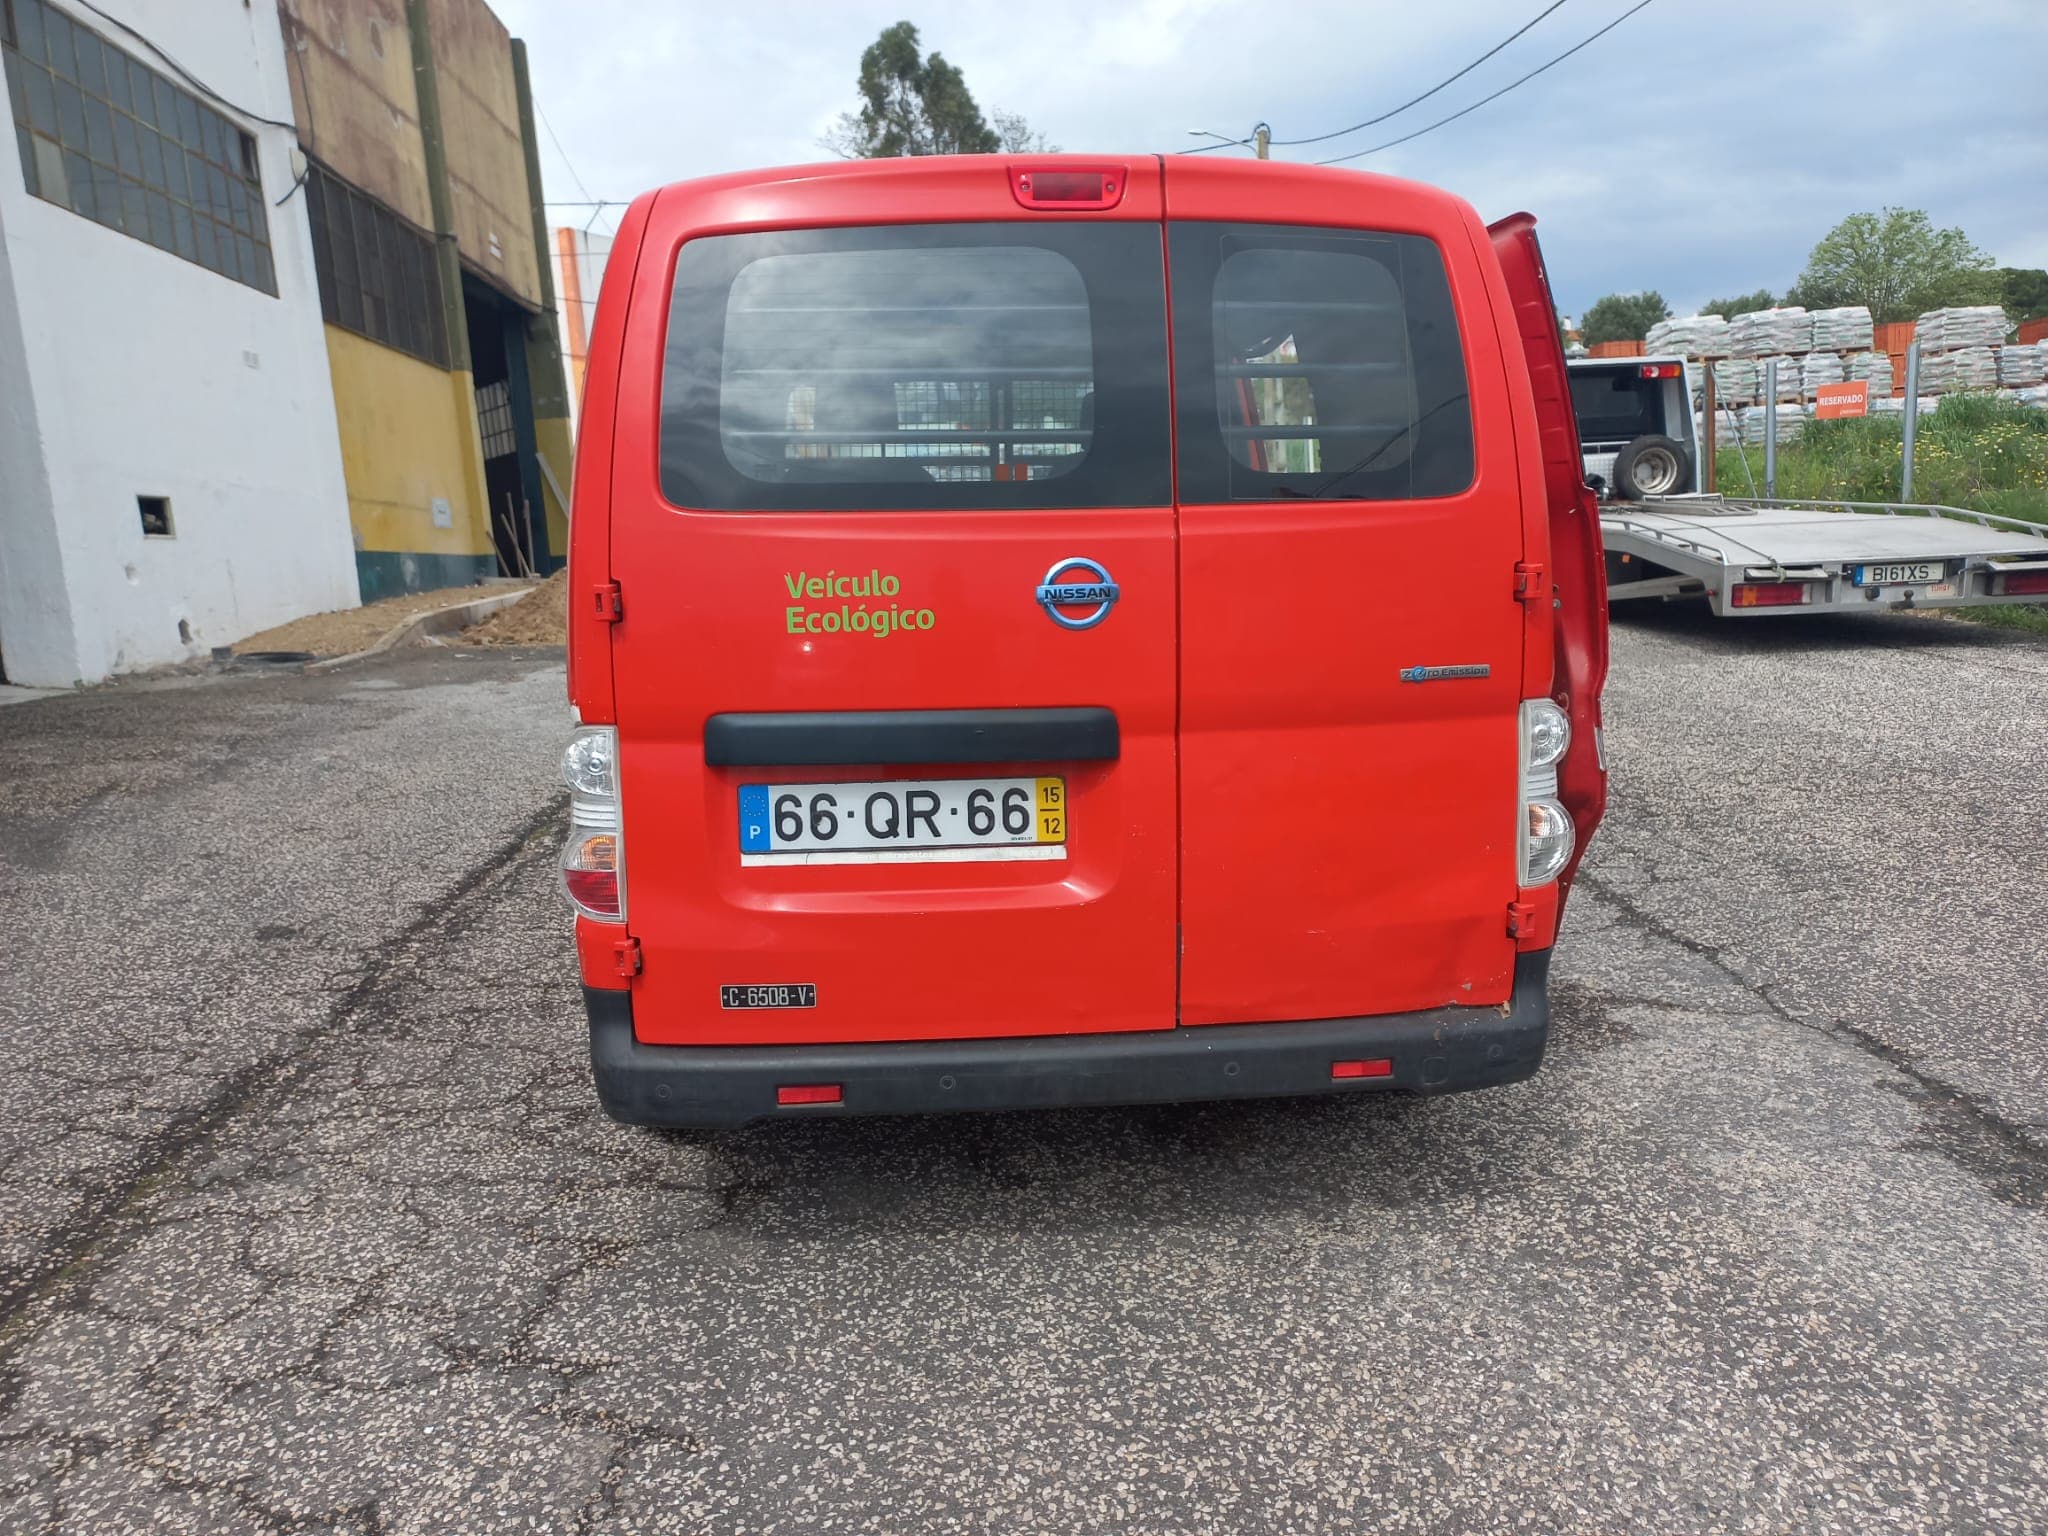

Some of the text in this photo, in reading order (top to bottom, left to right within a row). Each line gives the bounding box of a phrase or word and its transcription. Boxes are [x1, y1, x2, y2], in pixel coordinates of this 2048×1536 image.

[1819, 394, 1864, 407] RESERVADO
[785, 570, 900, 598] Veículo
[1044, 587, 1111, 600] NISSAN
[786, 604, 935, 638] Ecológico
[1042, 787, 1060, 804] 15
[749, 825, 761, 840] P
[1043, 818, 1061, 835] 12
[729, 986, 807, 1006] C-6508-V
